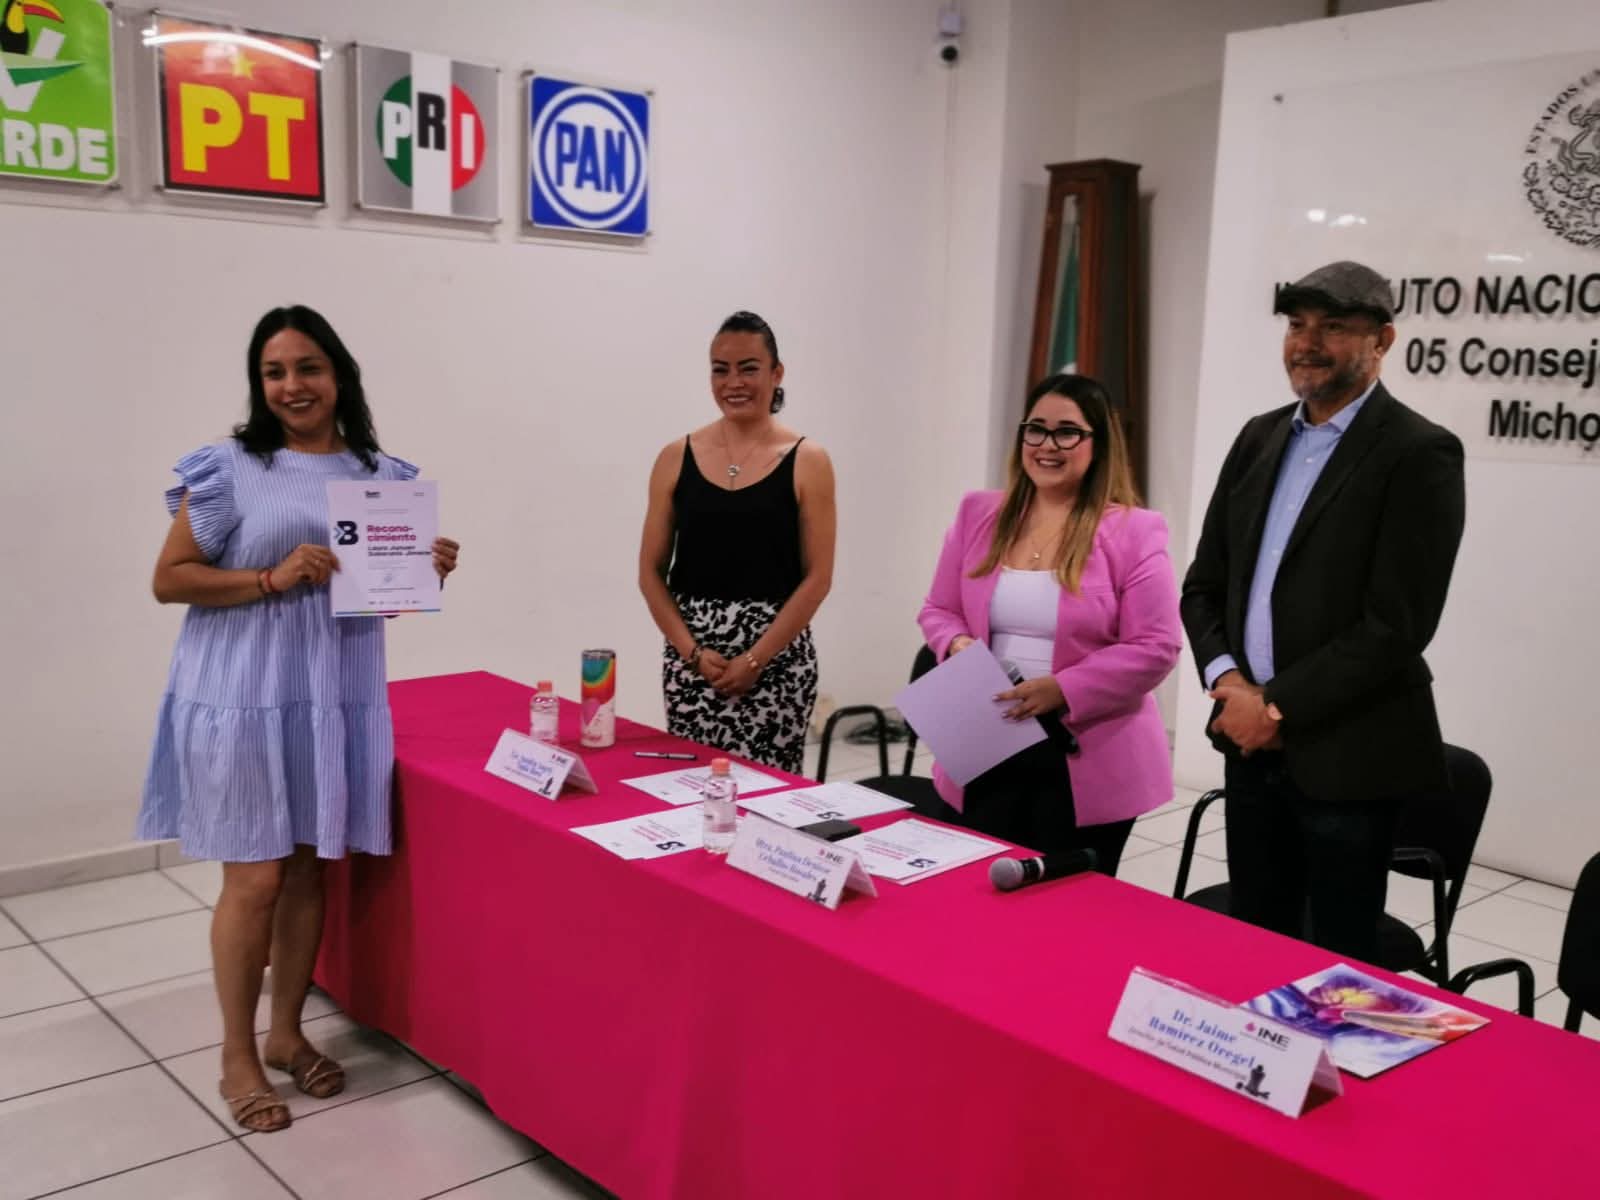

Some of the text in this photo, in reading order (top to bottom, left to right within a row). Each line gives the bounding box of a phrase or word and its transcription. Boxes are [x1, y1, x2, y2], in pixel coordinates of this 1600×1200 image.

[179, 83, 305, 180] PT
[382, 91, 476, 169] PRI
[555, 120, 626, 194] PAN
[1406, 338, 1447, 375] 05
[367, 533, 416, 542] cimiento
[825, 850, 844, 863] INE
[1197, 1020, 1237, 1043] Jaime
[1258, 1027, 1290, 1049] INE
